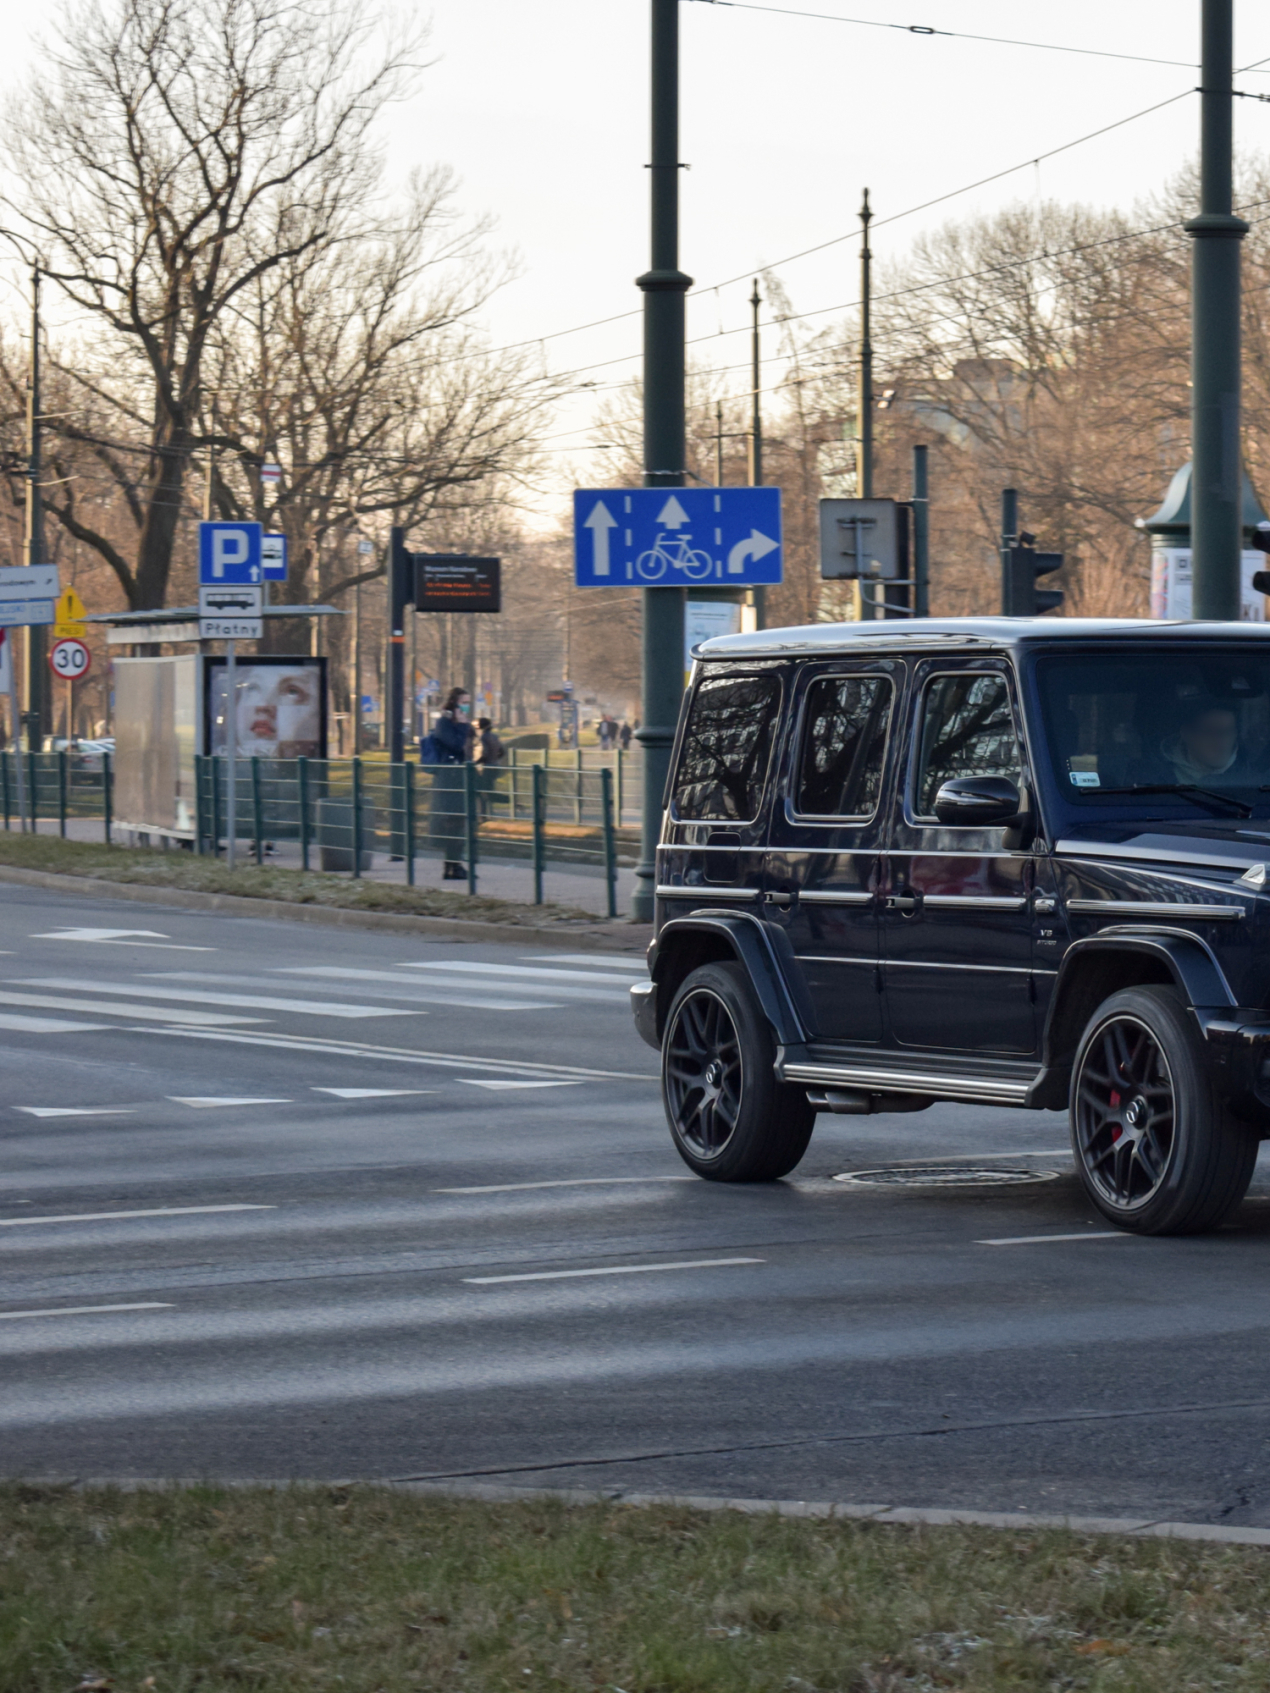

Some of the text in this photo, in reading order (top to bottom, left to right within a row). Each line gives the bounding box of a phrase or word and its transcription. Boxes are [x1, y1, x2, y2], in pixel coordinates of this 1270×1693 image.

[211, 529, 249, 577] P
[205, 623, 258, 637] Płatny
[56, 648, 86, 669] 30
